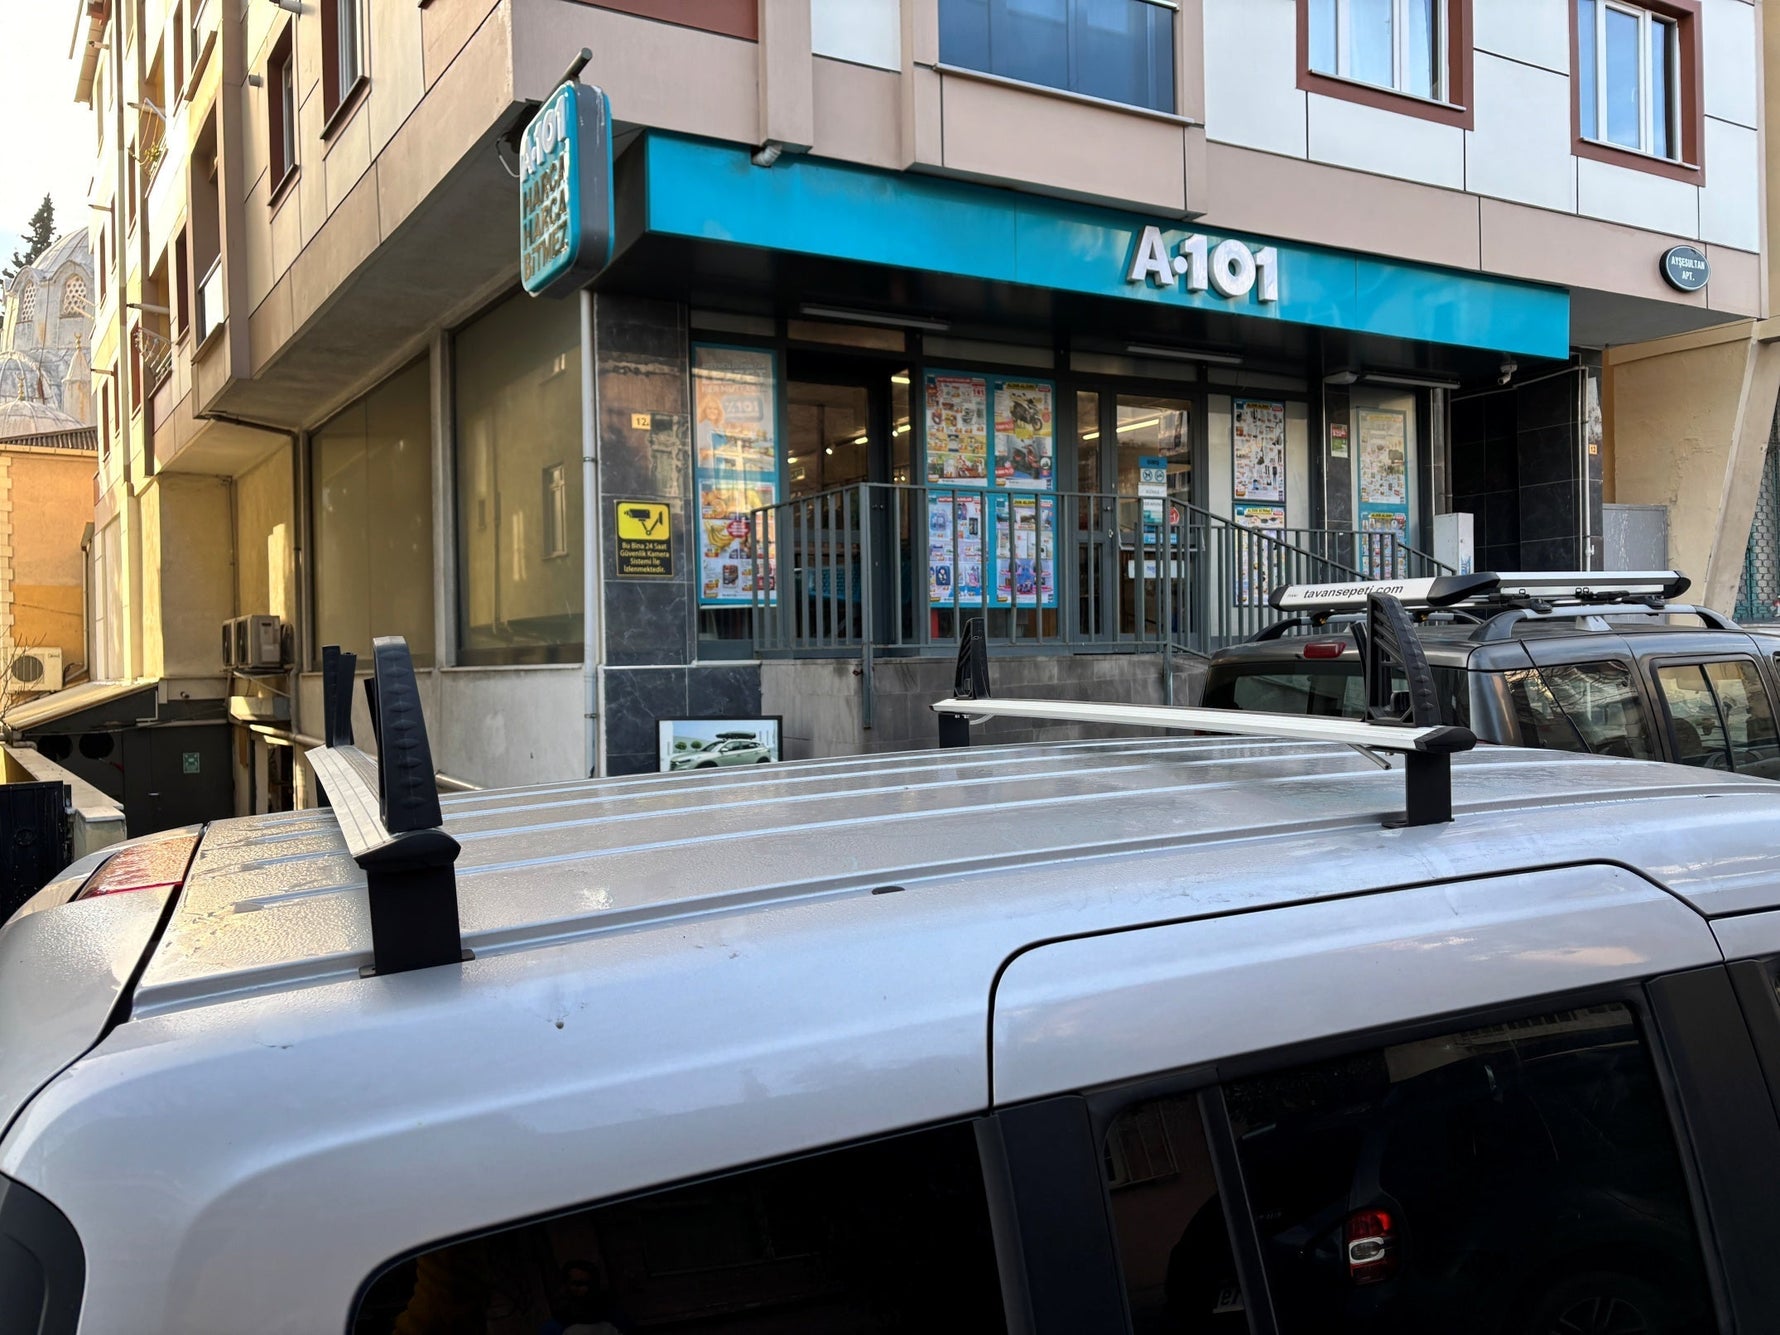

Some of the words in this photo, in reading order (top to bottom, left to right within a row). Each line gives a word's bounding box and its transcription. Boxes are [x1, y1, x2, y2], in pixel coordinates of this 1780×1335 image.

[1682, 271, 1695, 281] APT.
[620, 549, 646, 557] Güvenlik
[1304, 585, 1403, 598] tavansepeticom
